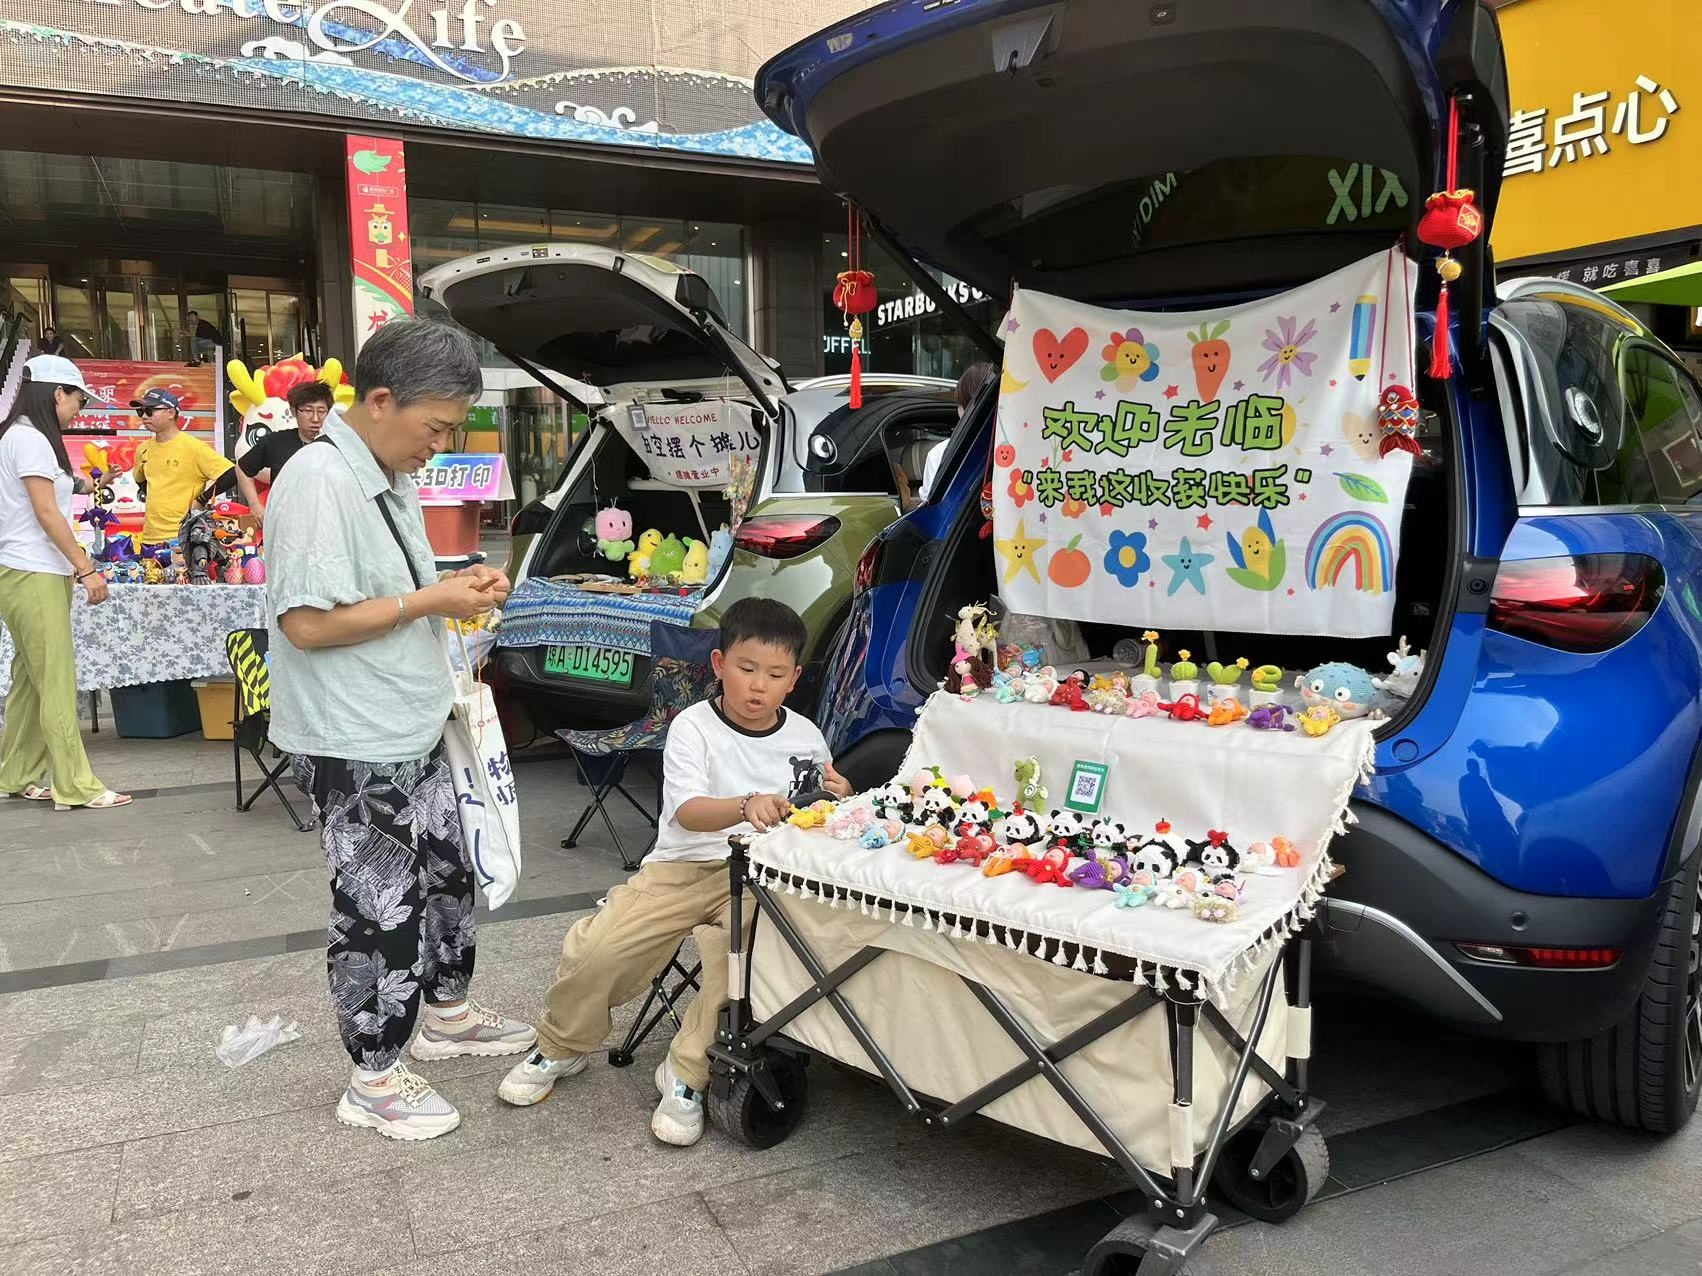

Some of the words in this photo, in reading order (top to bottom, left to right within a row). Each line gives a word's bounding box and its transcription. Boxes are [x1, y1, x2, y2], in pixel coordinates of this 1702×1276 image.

[877, 281, 969, 326] STARBUKS
[647, 415, 671, 425] HELLO
[674, 413, 718, 425] WELCOME
